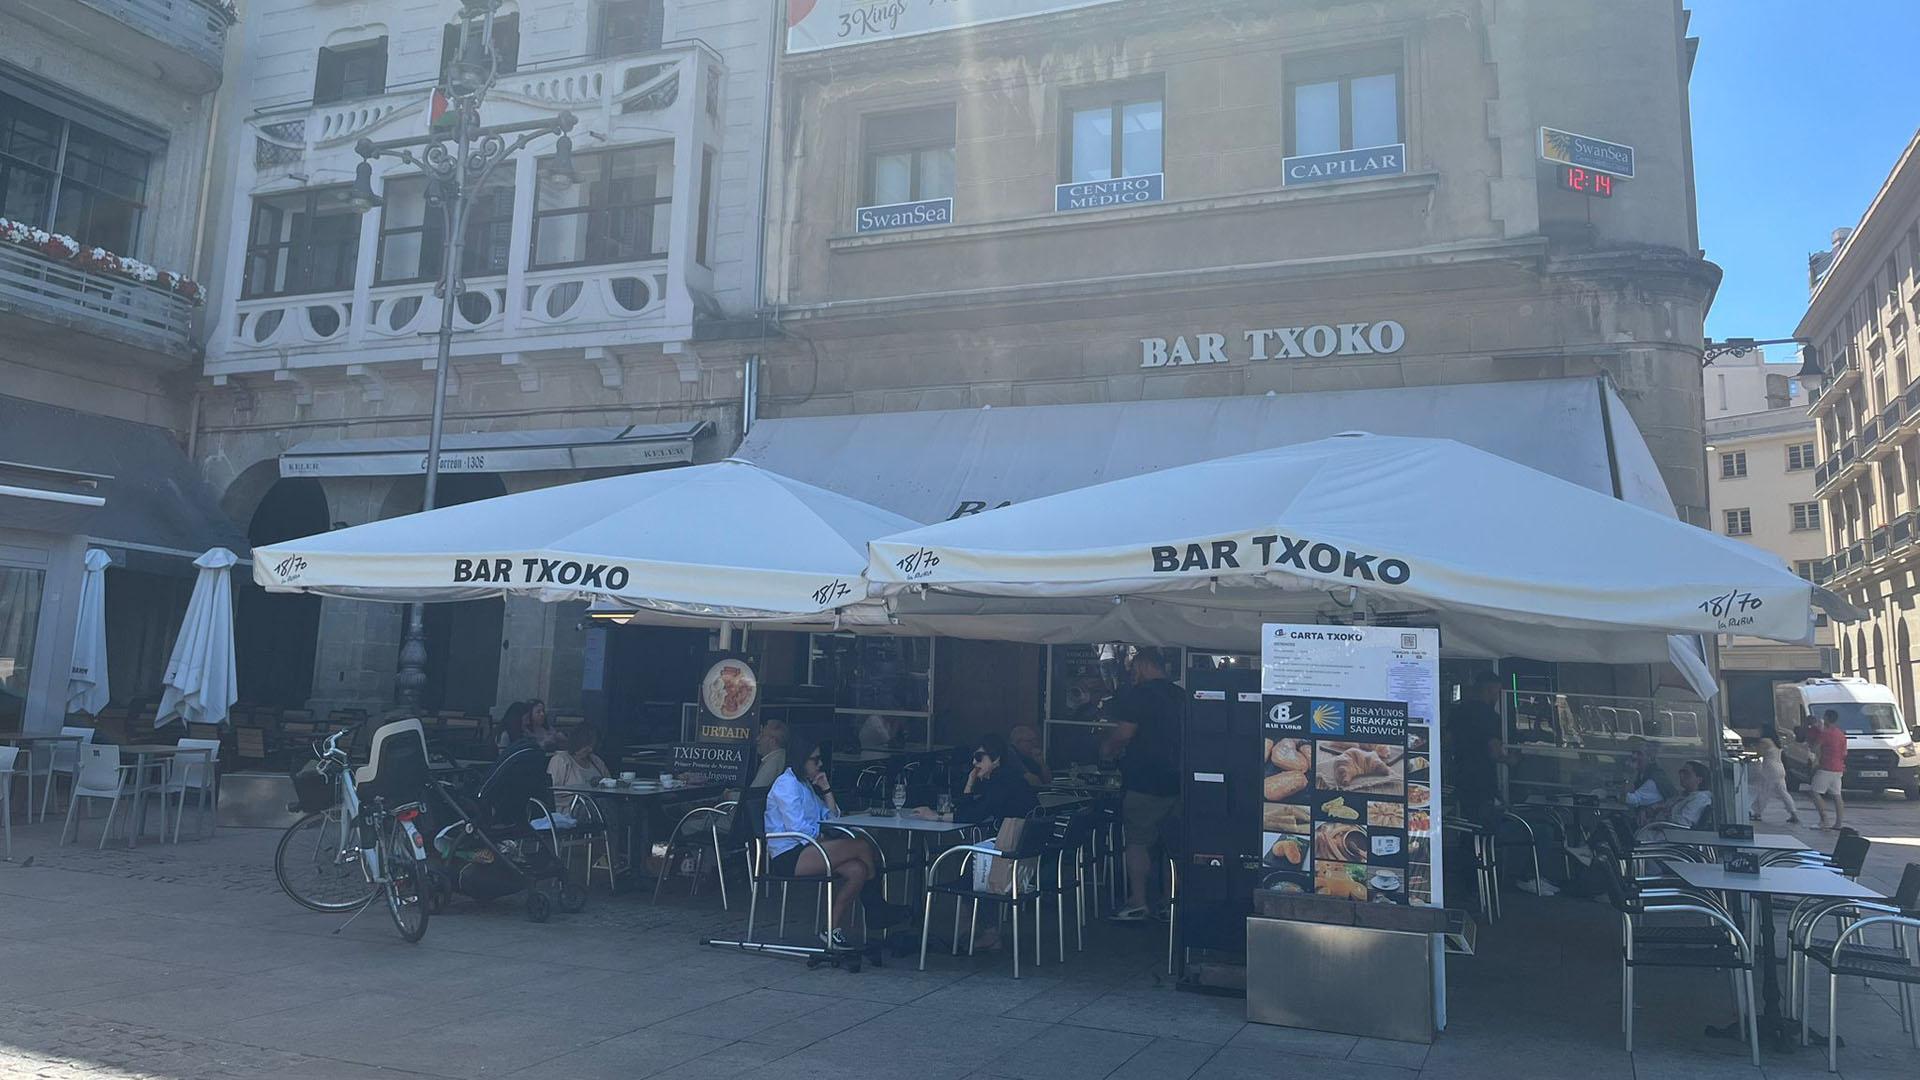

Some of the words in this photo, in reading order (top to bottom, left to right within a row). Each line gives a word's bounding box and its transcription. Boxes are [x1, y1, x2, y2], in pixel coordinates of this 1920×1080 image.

[1575, 138, 1629, 163] SwanSea
[1290, 154, 1397, 180] CAPILAR
[1069, 179, 1150, 197] CENTRO
[1567, 167, 1612, 196] 12:14
[1069, 190, 1150, 209] MÉDICO
[861, 204, 947, 230] SwanSea
[1139, 332, 1229, 368] BAR
[1244, 320, 1406, 361] TXOKO
[273, 553, 308, 577] 18/70
[896, 546, 940, 573] 18/70
[1151, 540, 1240, 572] BAR
[1252, 535, 1411, 585] TXOKO
[453, 558, 513, 583] BAR
[522, 558, 630, 591] TXOKO
[811, 578, 852, 605] 18/7
[1698, 589, 1763, 618] 18/70
[1290, 631, 1324, 641] CARTA
[1327, 632, 1363, 642] TXOKO
[1350, 706, 1405, 717] DESAYUNOS
[1350, 715, 1405, 727] BREAKFAST
[701, 725, 750, 739] URTAIN
[1350, 725, 1405, 736] SANDWICH
[672, 746, 742, 762] TXISTORRA
